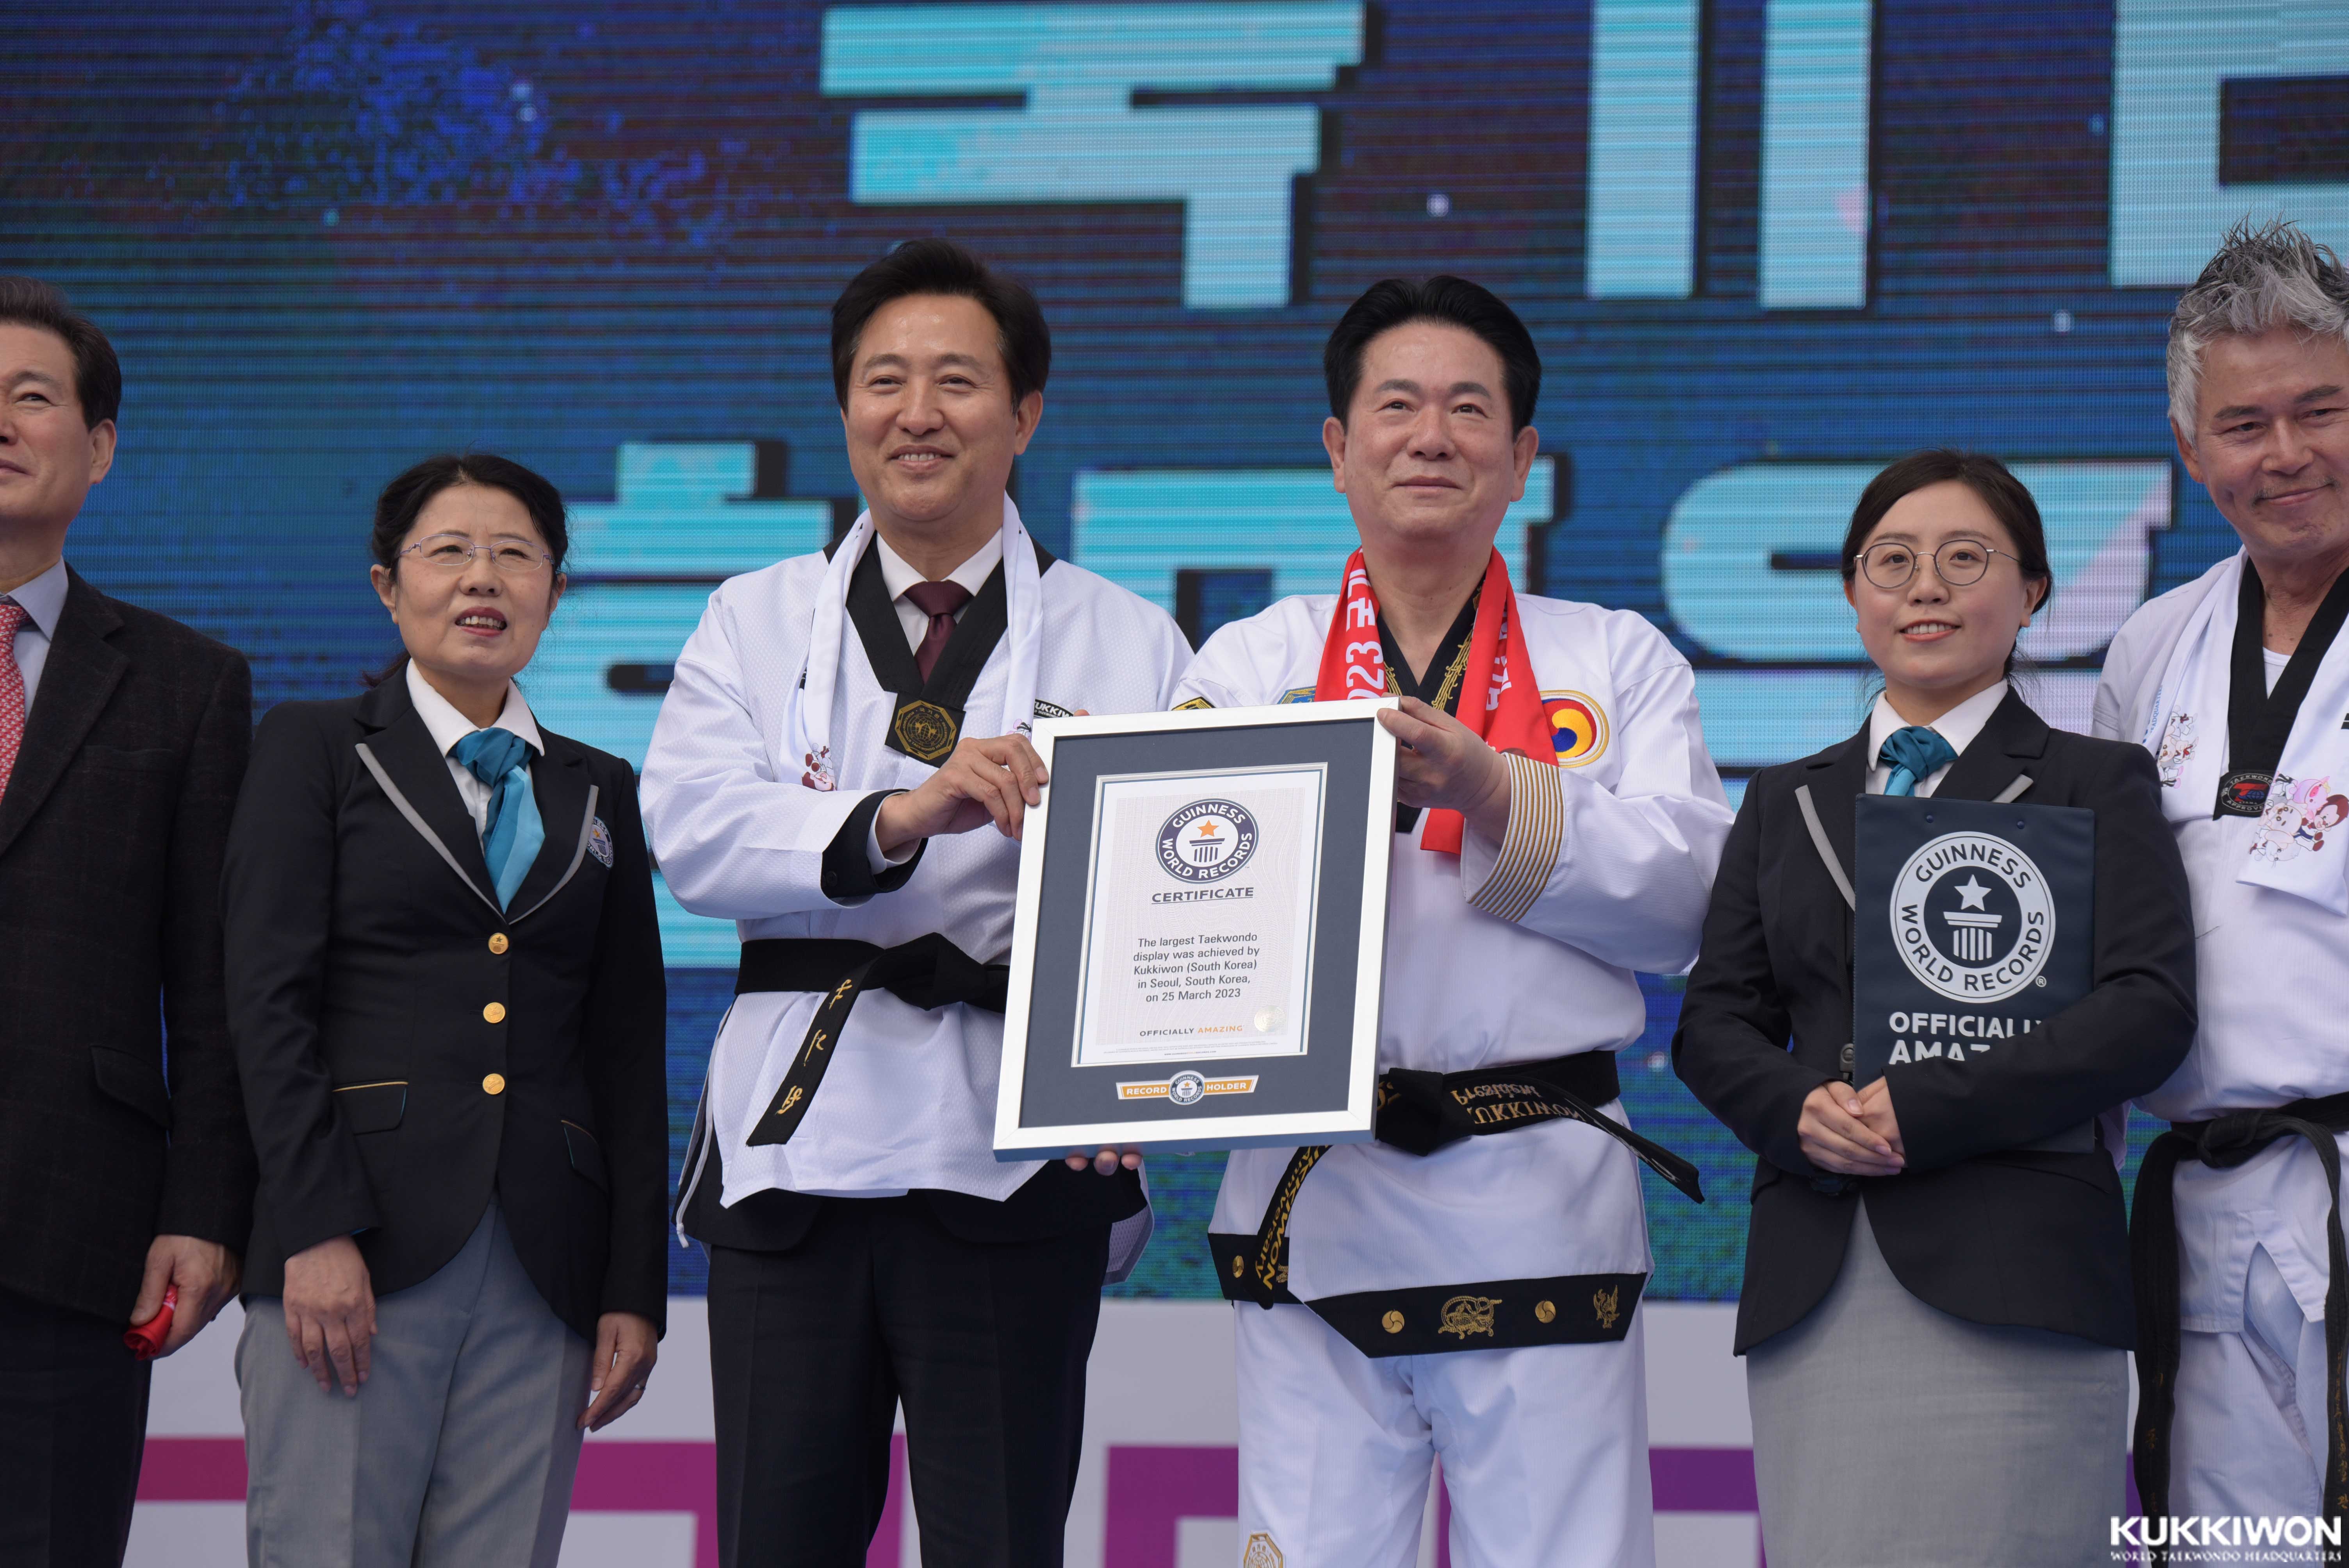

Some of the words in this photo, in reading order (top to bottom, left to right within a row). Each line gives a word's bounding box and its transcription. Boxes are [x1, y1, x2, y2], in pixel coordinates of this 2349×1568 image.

[2227, 800, 2264, 811] APPROVE
[1172, 804, 1246, 828] GUINNESS
[1162, 837, 1193, 877] WORLD
[1198, 832, 1252, 878] RECORDS
[1916, 843, 2032, 888] GUINNESS
[1151, 887, 1254, 903] CERTIFICATE
[1138, 938, 1157, 948] The
[1159, 936, 1195, 948] largest
[1198, 932, 1258, 944] Taekwondo
[1902, 904, 1953, 983] WORLD
[1133, 951, 1170, 963] display
[1173, 950, 1194, 959] was
[1198, 946, 1244, 958] achieved
[1247, 946, 1260, 957] by
[1964, 911, 2044, 991] RECORDS
[1134, 964, 1183, 975] Kukkiwon
[1187, 962, 1221, 973] (South
[1224, 959, 1257, 970] Korea)
[1137, 979, 1147, 989] in
[1150, 977, 1182, 989] Seoul,
[1185, 975, 1215, 986] South
[1219, 975, 1250, 984] Korea,
[1162, 992, 1174, 1001] 25
[1178, 990, 1212, 1000] March
[1214, 988, 1241, 999] 2023
[1139, 1028, 1194, 1037] OFFICIALLY
[1198, 1025, 1243, 1033] AMAZING
[1889, 1011, 2042, 1039] OFFICIAL
[1175, 1076, 1200, 1085] GUINNESS
[1206, 1082, 1247, 1091] HOLDER
[1126, 1087, 1167, 1095] RECORD
[1172, 1087, 1183, 1101] WORLD
[1183, 1086, 1202, 1102] RECORDS
